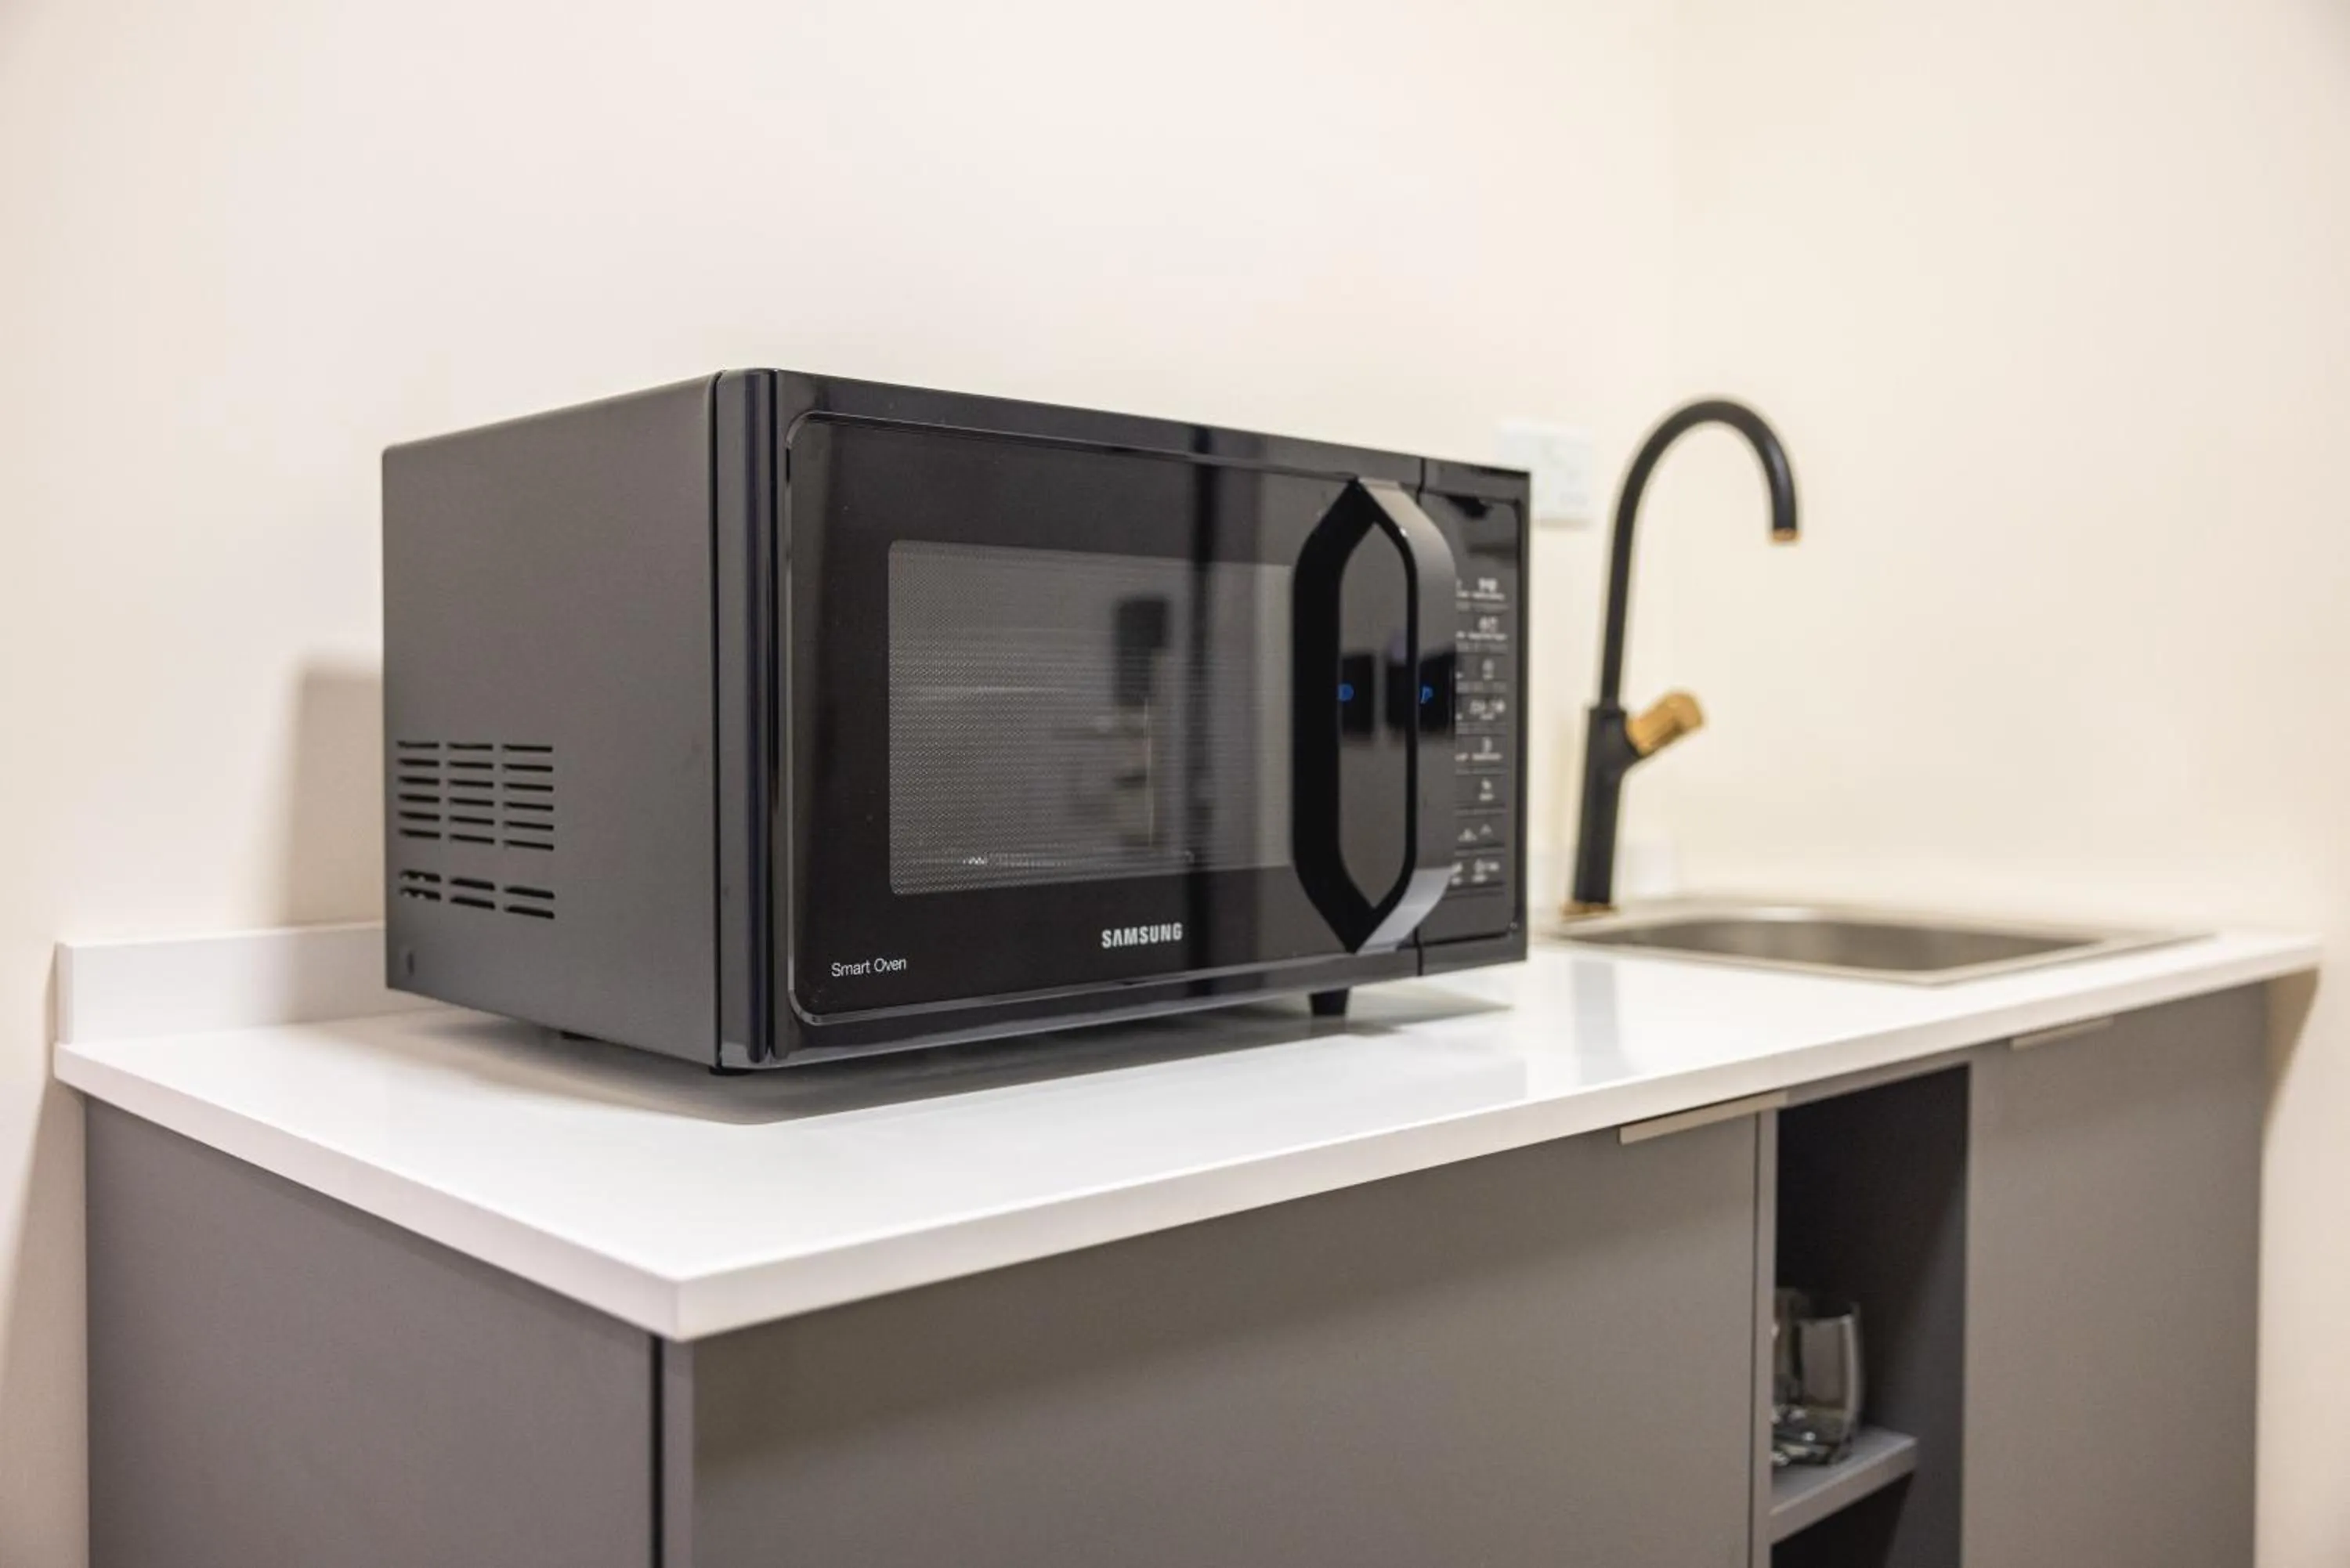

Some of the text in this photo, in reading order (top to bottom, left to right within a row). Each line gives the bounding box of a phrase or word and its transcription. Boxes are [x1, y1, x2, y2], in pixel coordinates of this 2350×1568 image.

[1101, 923, 1183, 948] SAMSUNG
[832, 958, 906, 977] Smart Oven
